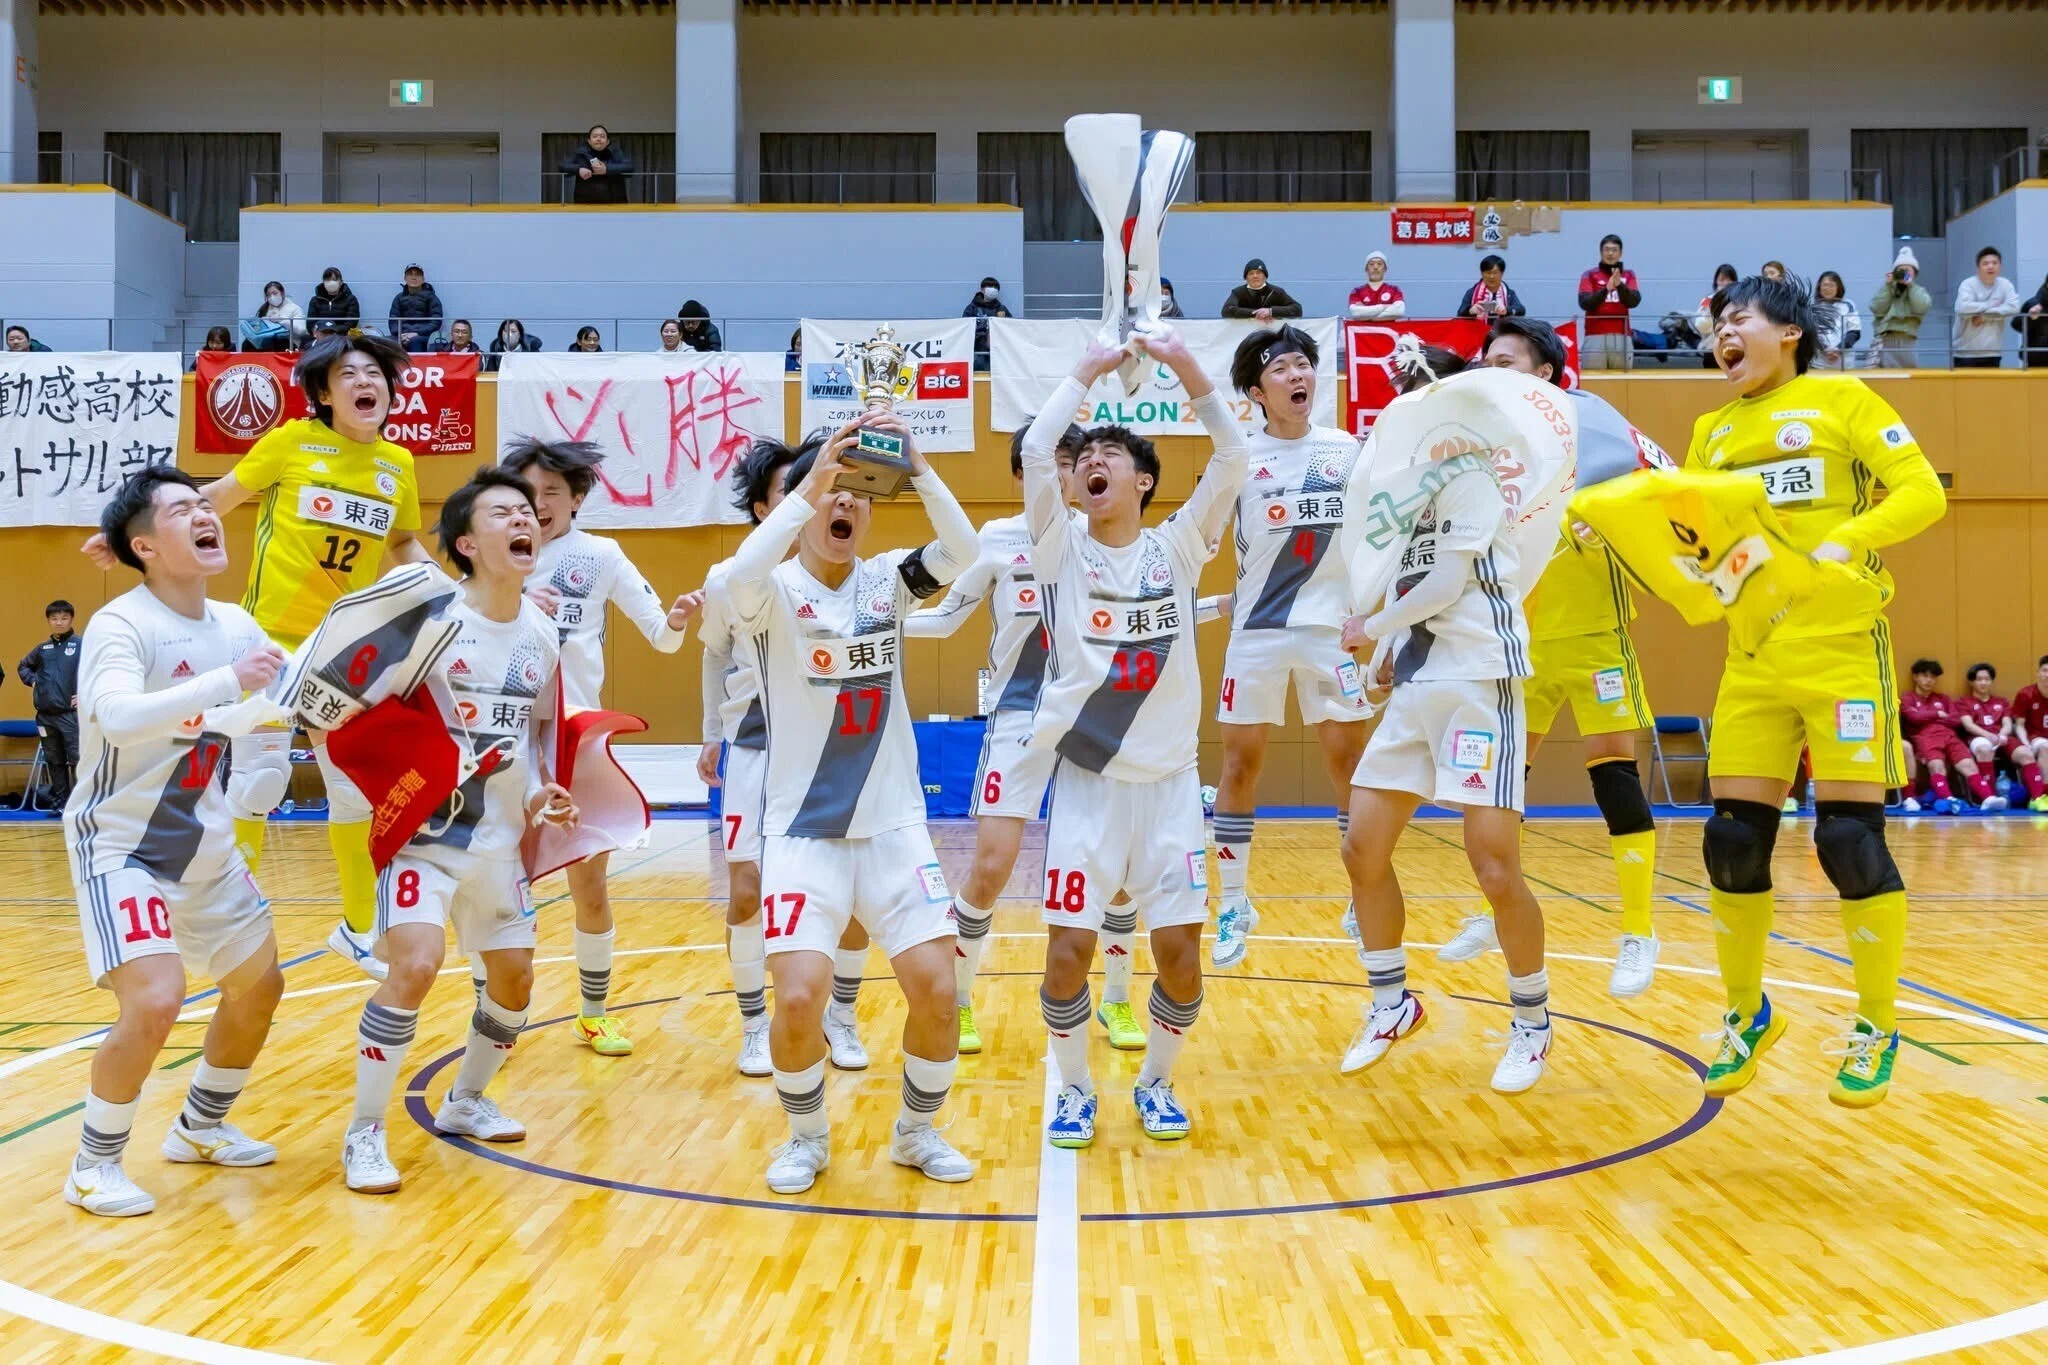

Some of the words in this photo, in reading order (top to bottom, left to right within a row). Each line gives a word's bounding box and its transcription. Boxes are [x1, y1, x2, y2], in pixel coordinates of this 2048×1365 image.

[812, 385, 854, 396] WINNER
[344, 500, 391, 531] 東急
[1297, 496, 1344, 520] 東急
[320, 535, 362, 573] 12
[1293, 531, 1315, 566] 4
[1400, 539, 1436, 572] 東急
[1126, 603, 1180, 634] 東急
[1112, 649, 1159, 692] 18
[300, 679, 347, 724] 東急
[1222, 677, 1235, 711] 4
[836, 688, 883, 736] 17
[983, 770, 1002, 804] 6
[1461, 782, 1487, 790] adidas
[726, 815, 743, 851] 7
[396, 869, 421, 908] 8
[1044, 868, 1086, 914] 18
[119, 896, 172, 943] 10
[763, 892, 806, 941] 17
